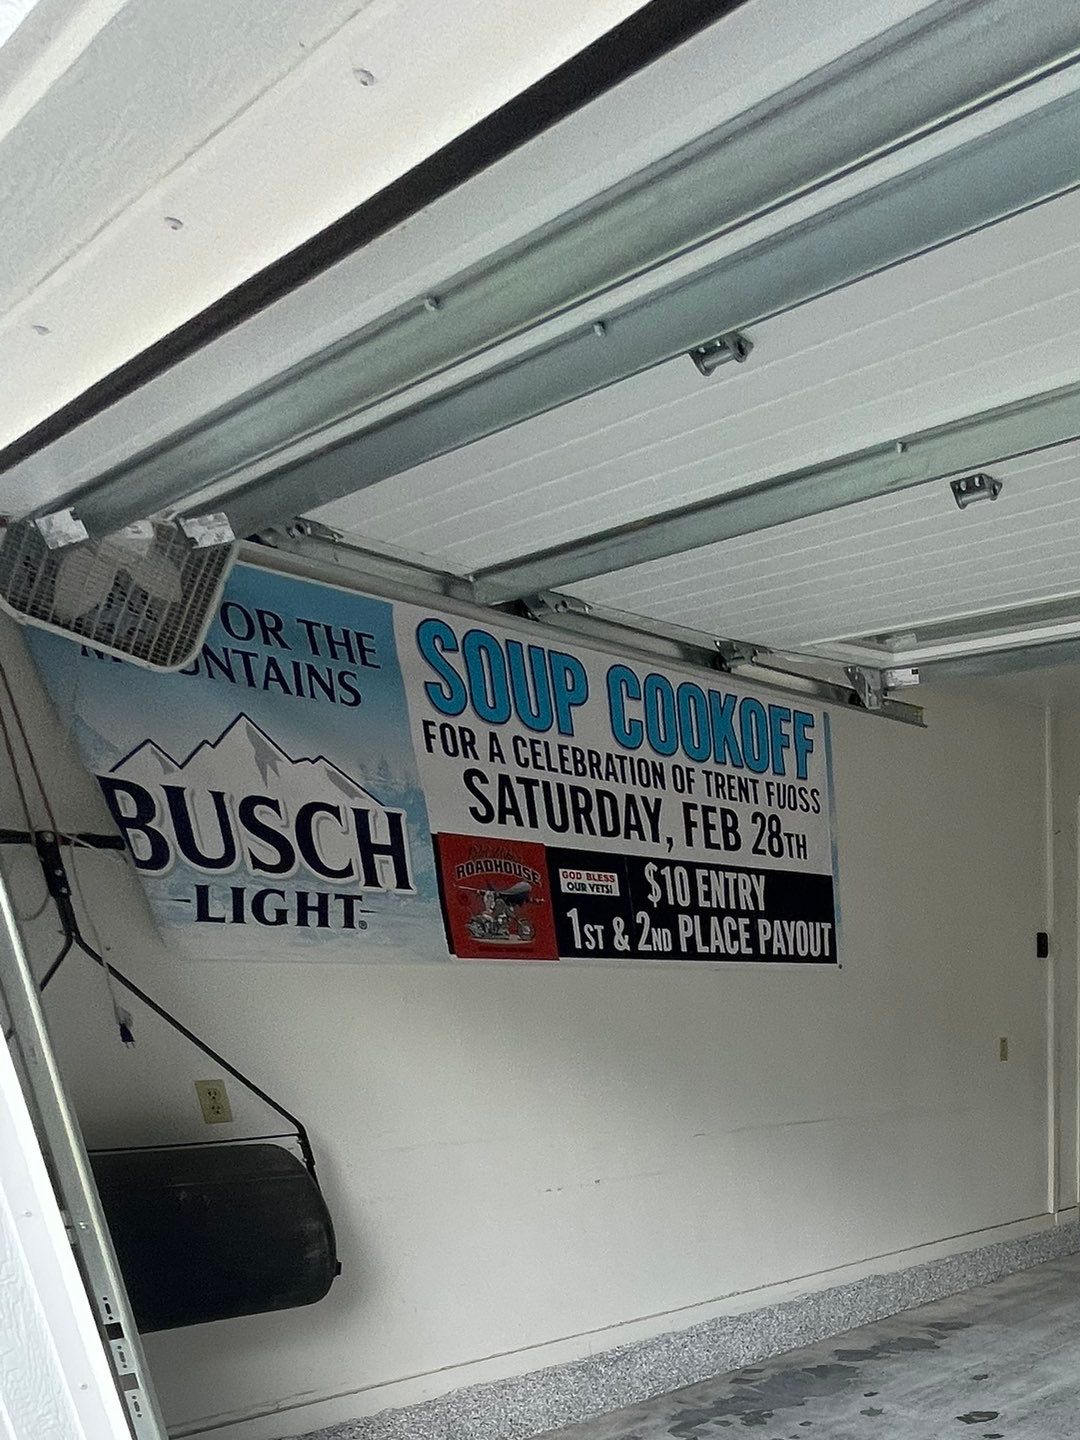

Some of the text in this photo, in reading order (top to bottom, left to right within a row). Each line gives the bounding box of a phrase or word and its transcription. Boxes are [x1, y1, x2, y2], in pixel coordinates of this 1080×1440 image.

[220, 602, 382, 670] OR THE
[415, 618, 815, 781] SOUP COOKOFF
[422, 719, 822, 814] FOR A CELEBRATION OF TRENT FUOSS
[96, 775, 412, 892] BUSCH
[463, 768, 809, 861] SATURDAY, FEB 28TH
[455, 858, 543, 888] ROADHOUSE
[562, 871, 615, 883] GOD BLESS
[567, 882, 613, 894] OUR VETS!
[644, 862, 767, 911] $10 ENTRY
[194, 885, 363, 930] LIGHT
[566, 907, 832, 957] 1ST & 2ND PLACE PAYOUT
